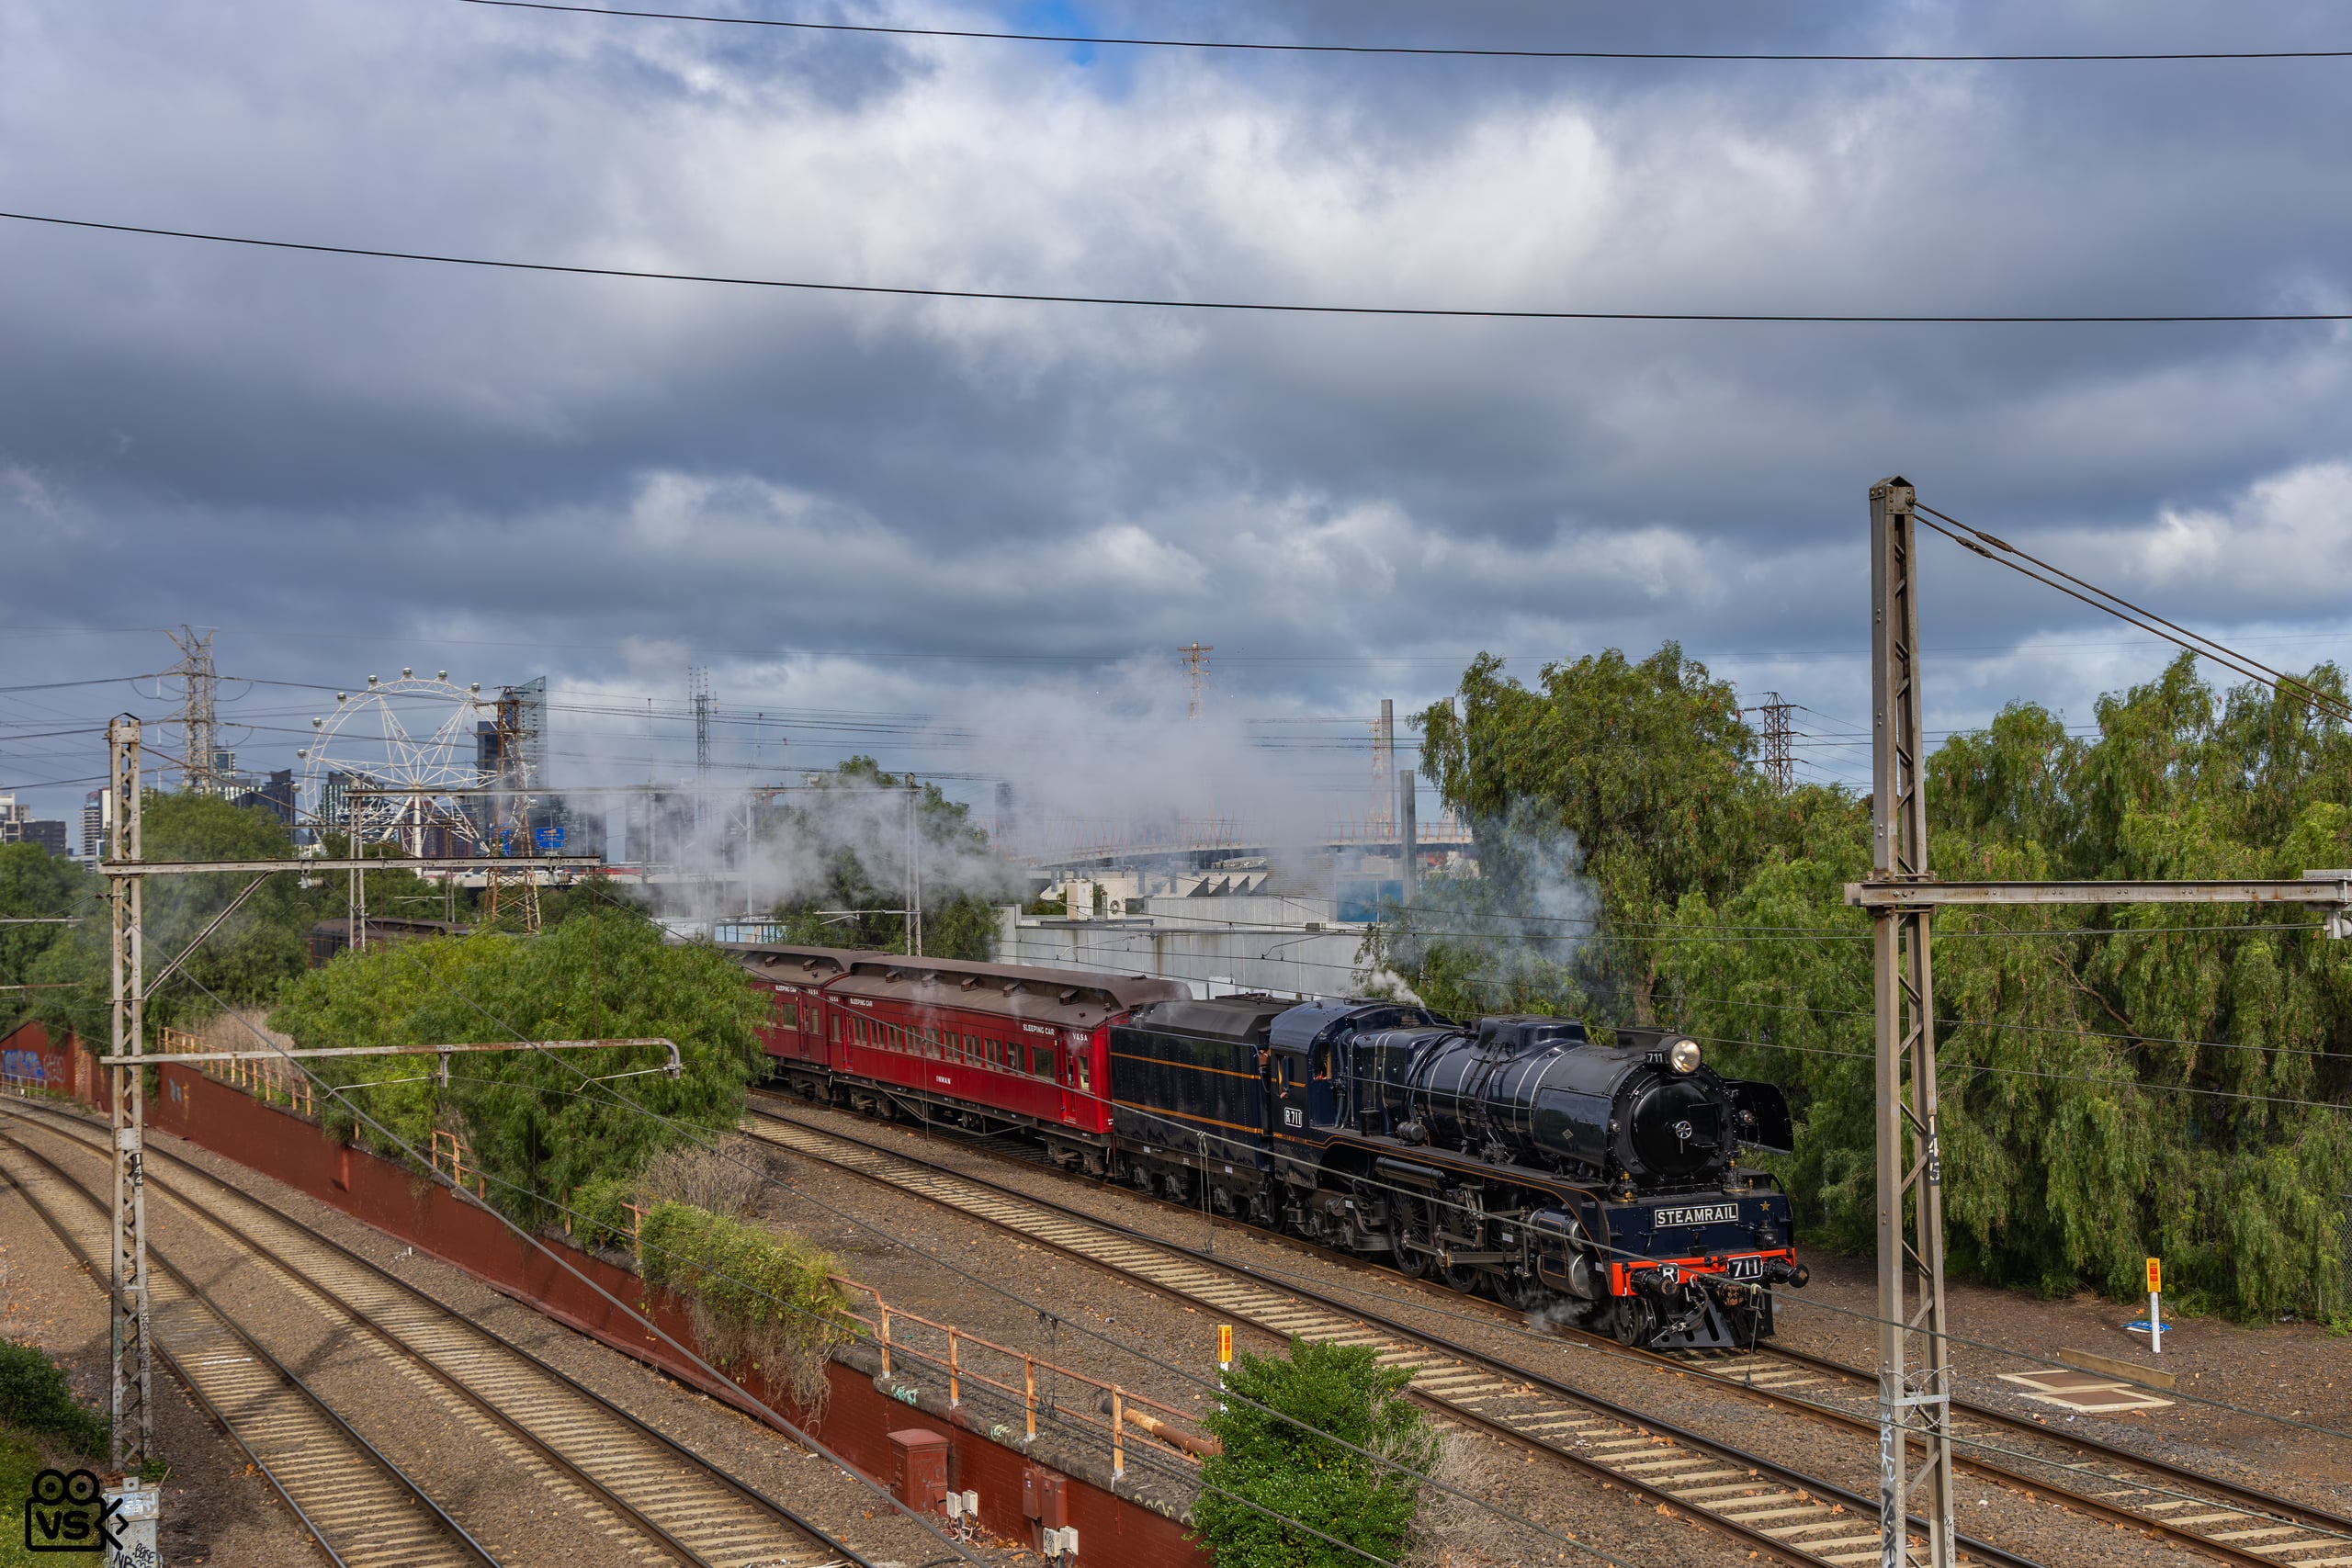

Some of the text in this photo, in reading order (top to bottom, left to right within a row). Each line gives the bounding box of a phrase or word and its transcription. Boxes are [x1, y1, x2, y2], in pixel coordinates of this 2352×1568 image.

[1023, 1023, 1055, 1036] SLEEPING CAR
[1647, 1053, 1663, 1063] 711
[1657, 1206, 1736, 1224] STEAMRAIL
[1732, 1258, 1758, 1278] 711
